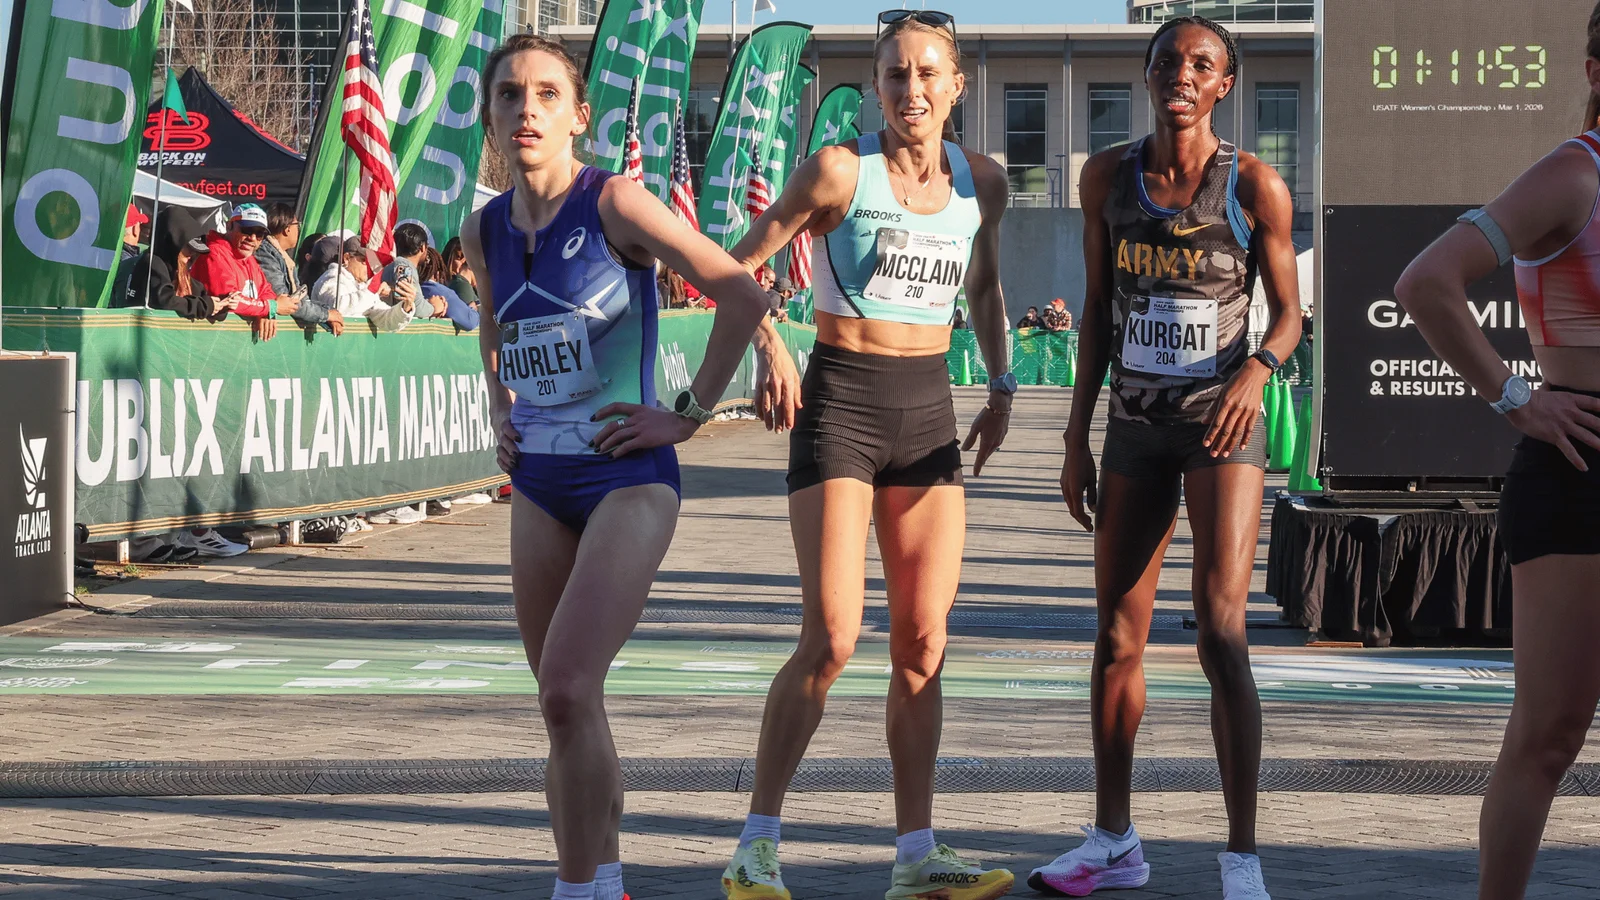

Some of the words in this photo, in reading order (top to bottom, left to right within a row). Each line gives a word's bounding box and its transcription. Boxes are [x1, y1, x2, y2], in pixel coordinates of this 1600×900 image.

[1437, 104, 1491, 112] Championship
[1498, 103, 1513, 111] Mar
[138, 152, 181, 161] BACK
[182, 152, 207, 161] ON
[853, 208, 903, 223] BROOKS
[1117, 238, 1204, 280] ARMY
[876, 253, 963, 287] MCCLAIN
[904, 284, 924, 299] 210
[535, 321, 565, 330] MARATHON
[1128, 316, 1210, 351] KURGAT
[502, 339, 582, 381] HURLEY
[1155, 351, 1176, 366] 204
[1369, 360, 1461, 377] OFFICIA
[536, 379, 557, 396] 201
[1369, 381, 1384, 396] &
[1390, 381, 1465, 396] RESULTS
[240, 377, 391, 474] ATLANTA
[14, 509, 51, 543] ATLANTA
[14, 543, 35, 558] TRACK
[37, 539, 51, 554] CLUB
[929, 872, 981, 884] BROOKS
